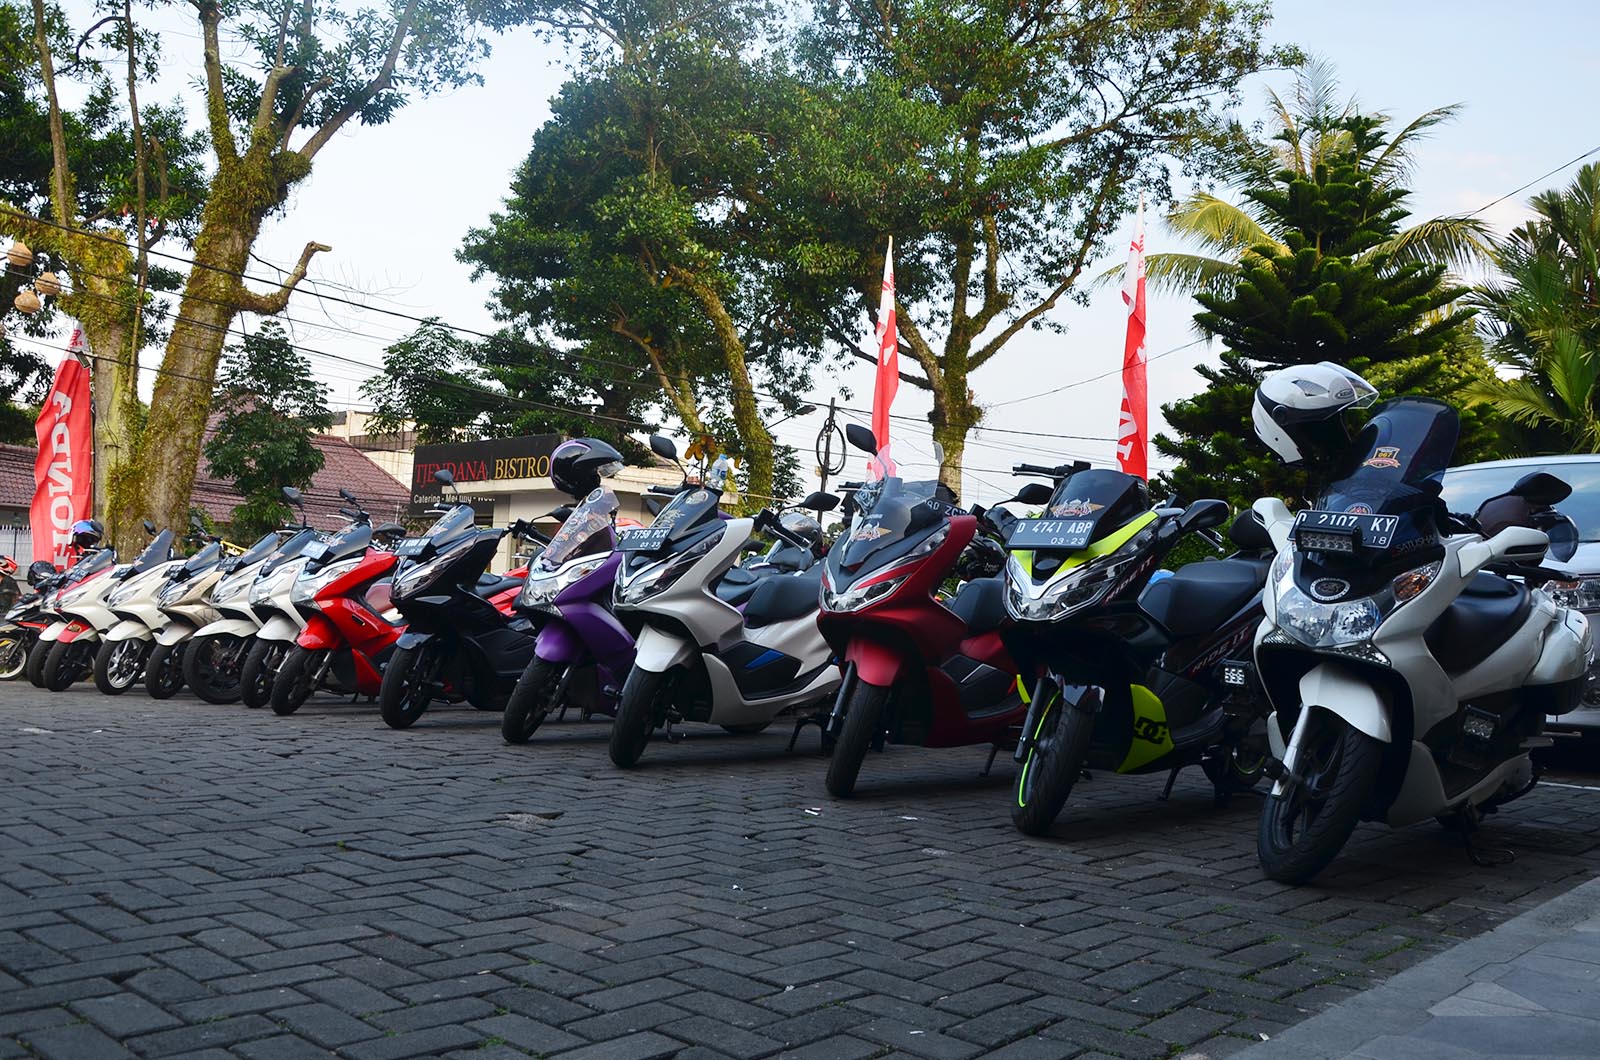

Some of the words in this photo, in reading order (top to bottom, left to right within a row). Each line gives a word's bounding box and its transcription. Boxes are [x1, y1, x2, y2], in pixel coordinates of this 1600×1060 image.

[494, 455, 550, 480] BISTRO
[413, 494, 441, 504] Catering
[1016, 522, 1026, 533] D
[1031, 522, 1063, 533] 4741
[1067, 522, 1094, 534] ABP
[1318, 514, 1358, 527] 2107
[1370, 517, 1395, 532] KY
[652, 529, 668, 539] PCX
